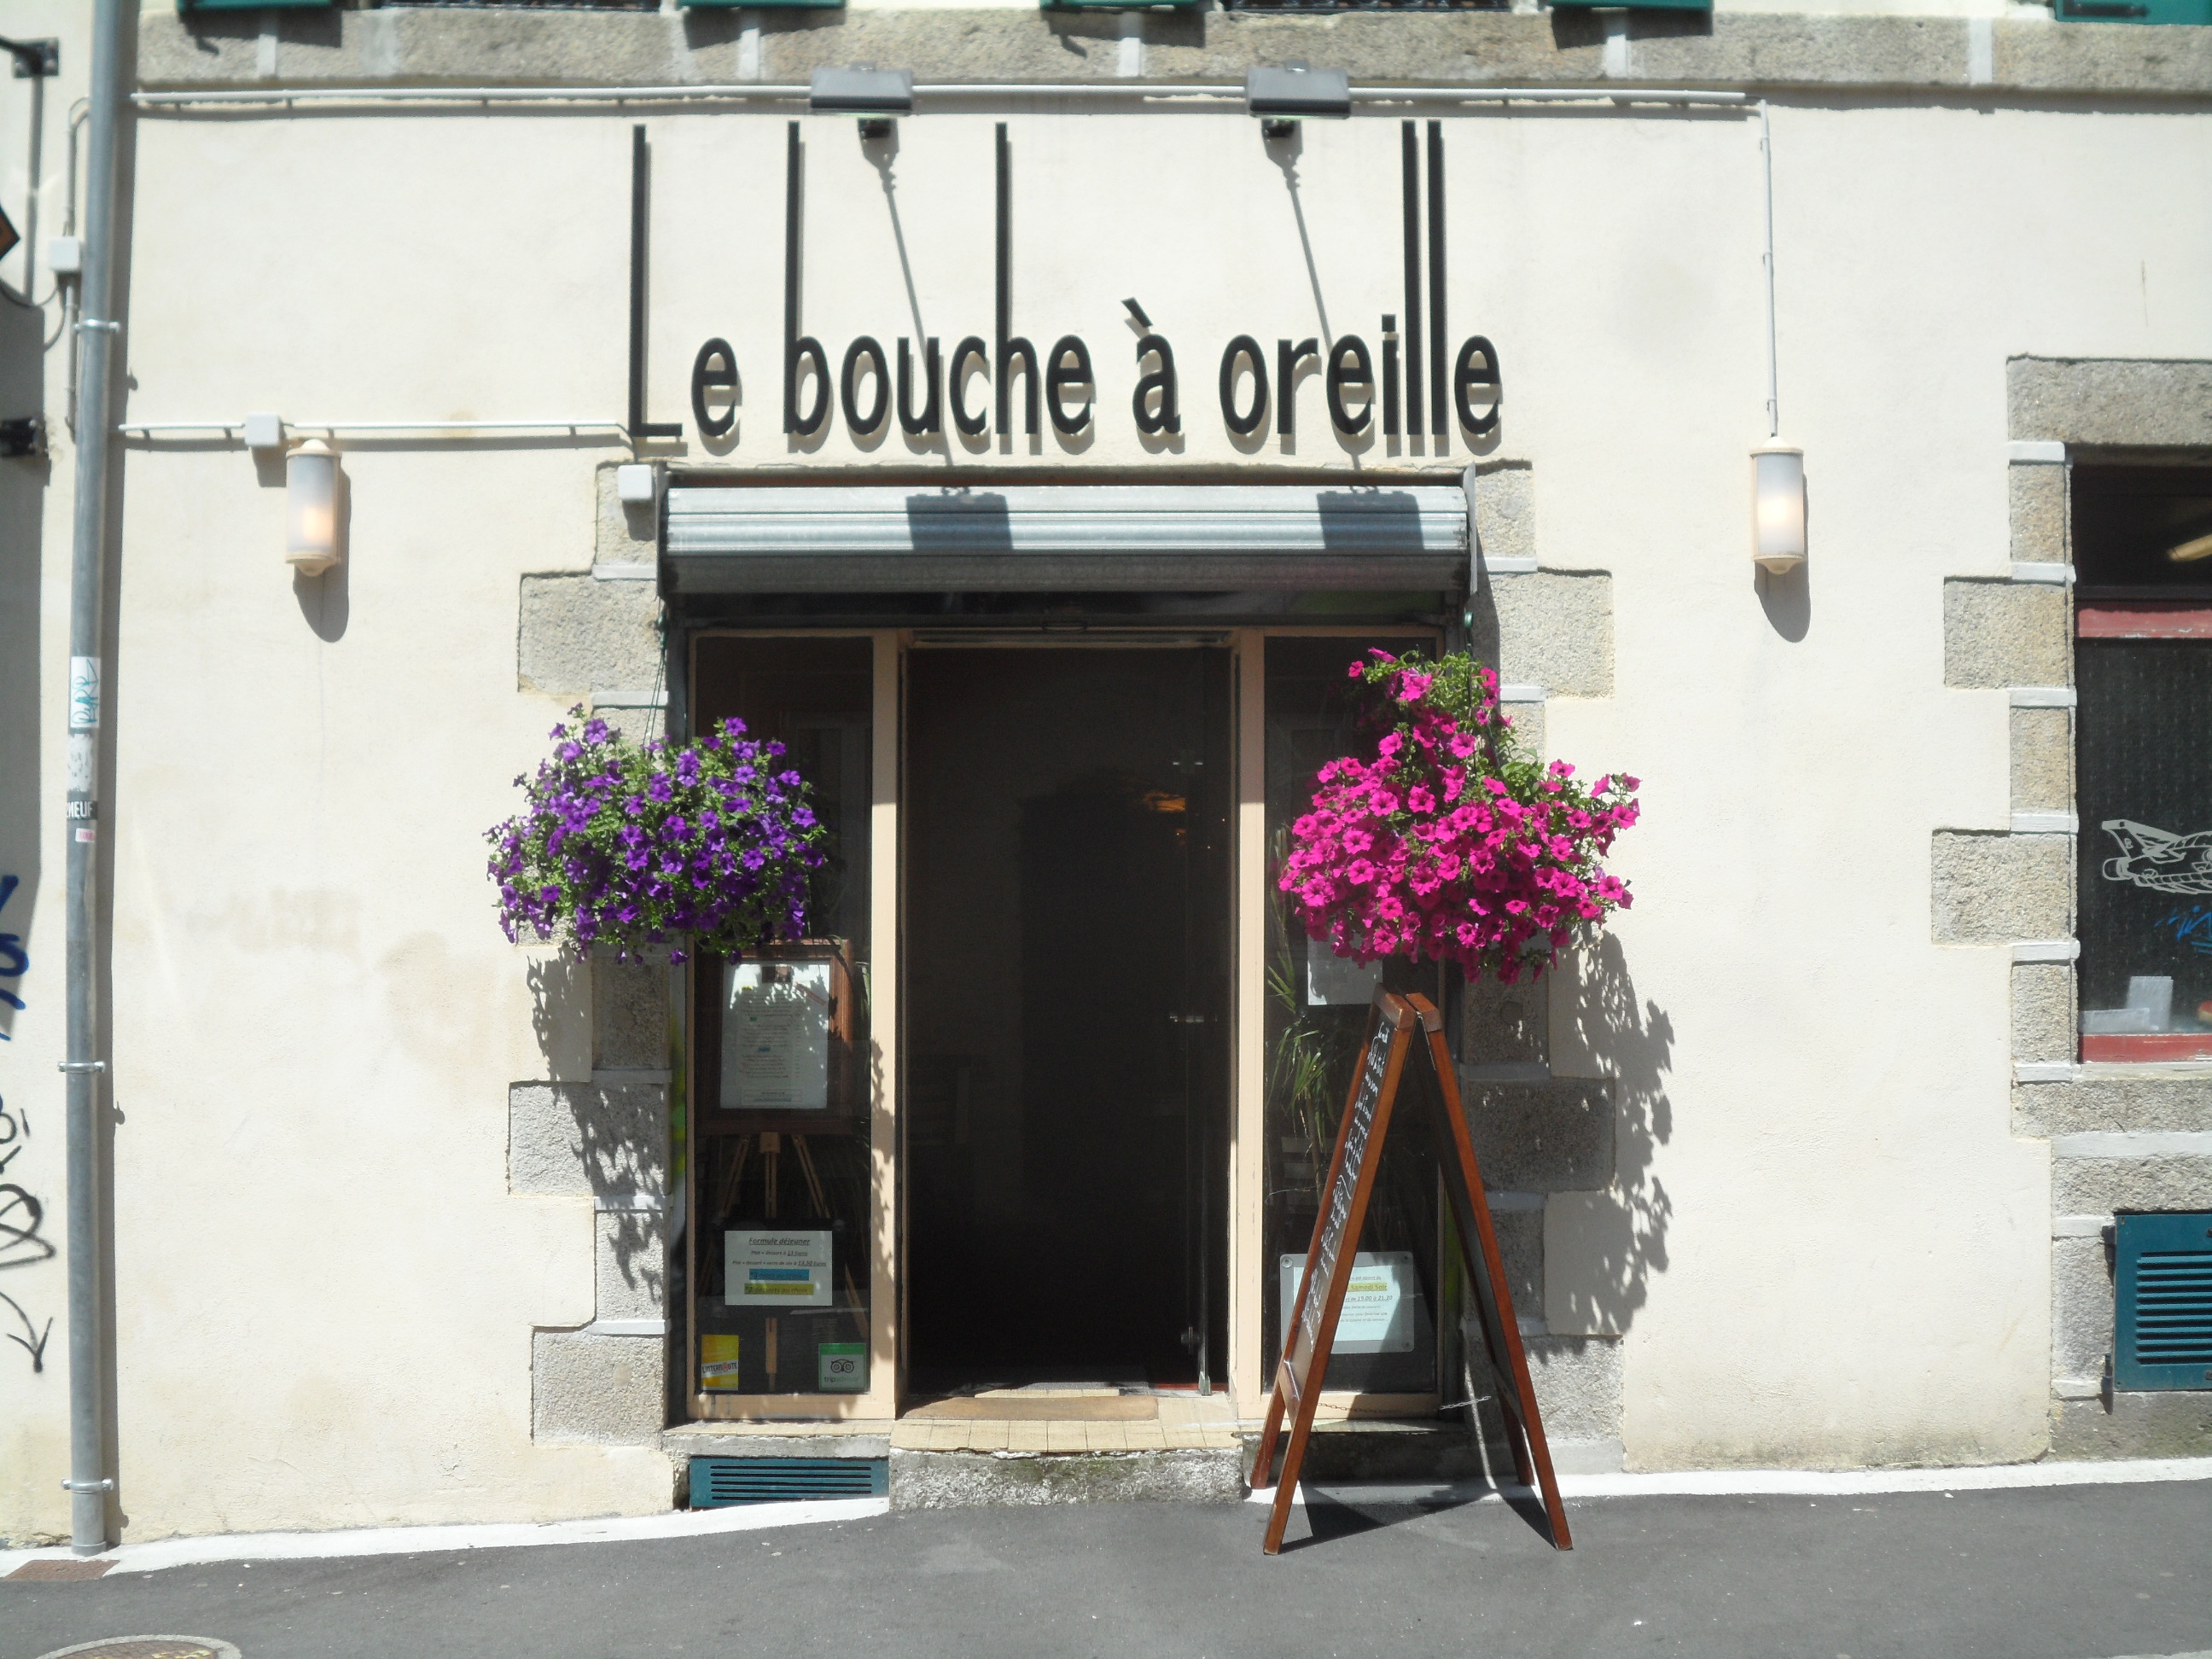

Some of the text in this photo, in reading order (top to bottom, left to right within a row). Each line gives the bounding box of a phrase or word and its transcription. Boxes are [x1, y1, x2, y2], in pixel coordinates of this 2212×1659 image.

[628, 119, 1502, 438] Le bouche à oreille
[749, 1237, 811, 1246] Formule déjeuner
